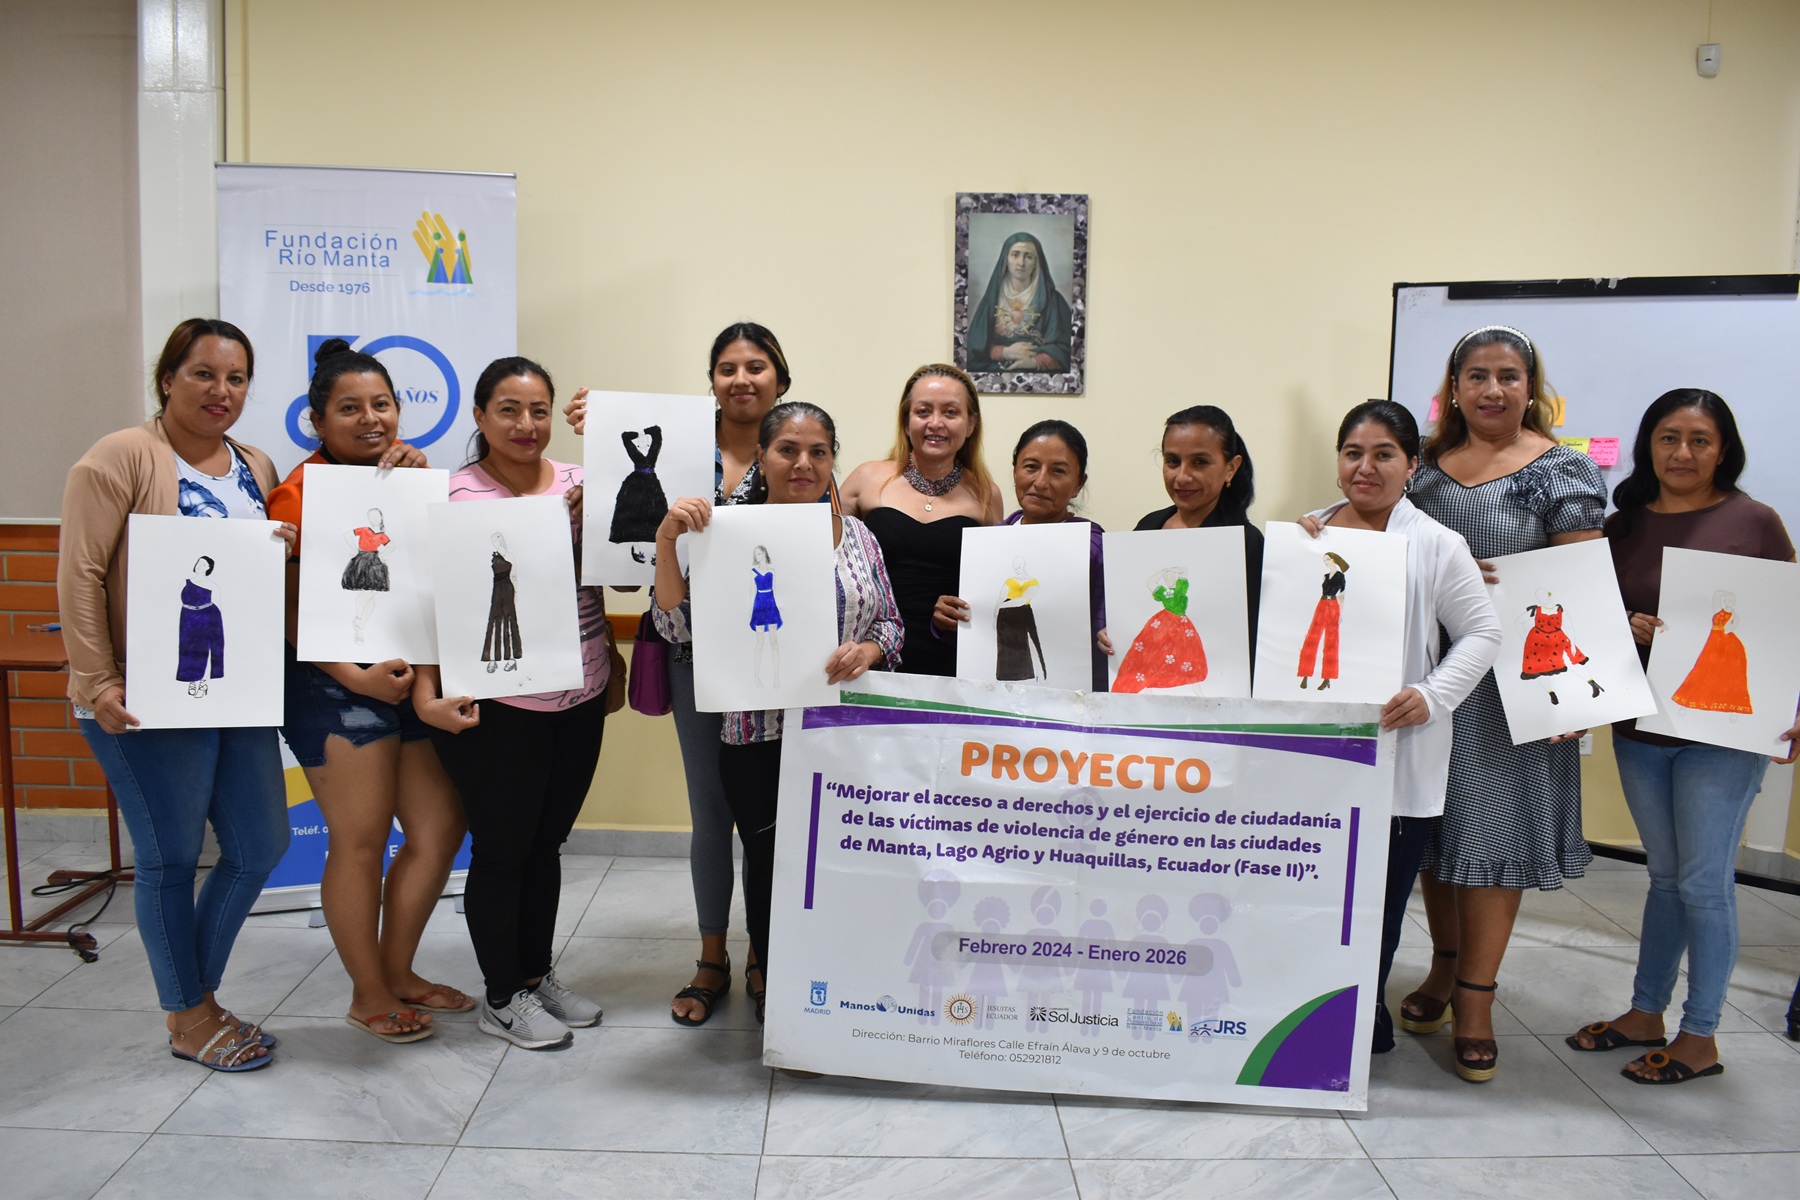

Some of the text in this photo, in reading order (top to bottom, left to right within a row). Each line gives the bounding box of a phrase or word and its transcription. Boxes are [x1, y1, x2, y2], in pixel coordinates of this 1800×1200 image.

[265, 230, 398, 250] Fundación
[279, 249, 390, 267] Río Manta
[289, 280, 371, 295] Desde 1976
[961, 741, 1211, 793] PROYECTO
[914, 789, 930, 804] el
[933, 793, 993, 808] acceso
[997, 798, 1008, 810] a
[1013, 797, 1093, 816] derechos
[1096, 805, 1109, 820] y
[1113, 804, 1130, 818] el
[1134, 807, 1210, 824] ejercicio
[1215, 810, 1236, 825] de
[1240, 811, 1342, 829] ciudadanía
[292, 825, 320, 836] Teléf.
[841, 810, 1322, 854] de las víctimas de violencia de género en las ciudades
[840, 835, 862, 850] de
[867, 839, 931, 860] Manta,
[936, 843, 978, 862] Lago
[982, 844, 1029, 863] Agrio
[1032, 850, 1045, 865] y
[1049, 849, 1152, 872] Huaquillas,
[1157, 857, 1231, 874] Ecuador
[1234, 858, 1281, 877] (Fase
[959, 938, 1027, 956] Febrero
[1032, 941, 1072, 957] 2024
[1088, 945, 1140, 962] Enero
[1145, 948, 1187, 965] 2026
[804, 1007, 831, 1015] MADRID
[840, 1000, 936, 1017] Manos Unidas
[986, 1013, 1018, 1021] ECUADOR
[987, 1005, 1016, 1013] JESUITAS
[1213, 1020, 1247, 1035] JRS
[852, 1028, 1171, 1060] Dirección: Barrio Miraflores Calle Efraín Álava y 9 de octubre
[959, 1050, 1061, 1064] Teléfono: 052921812
